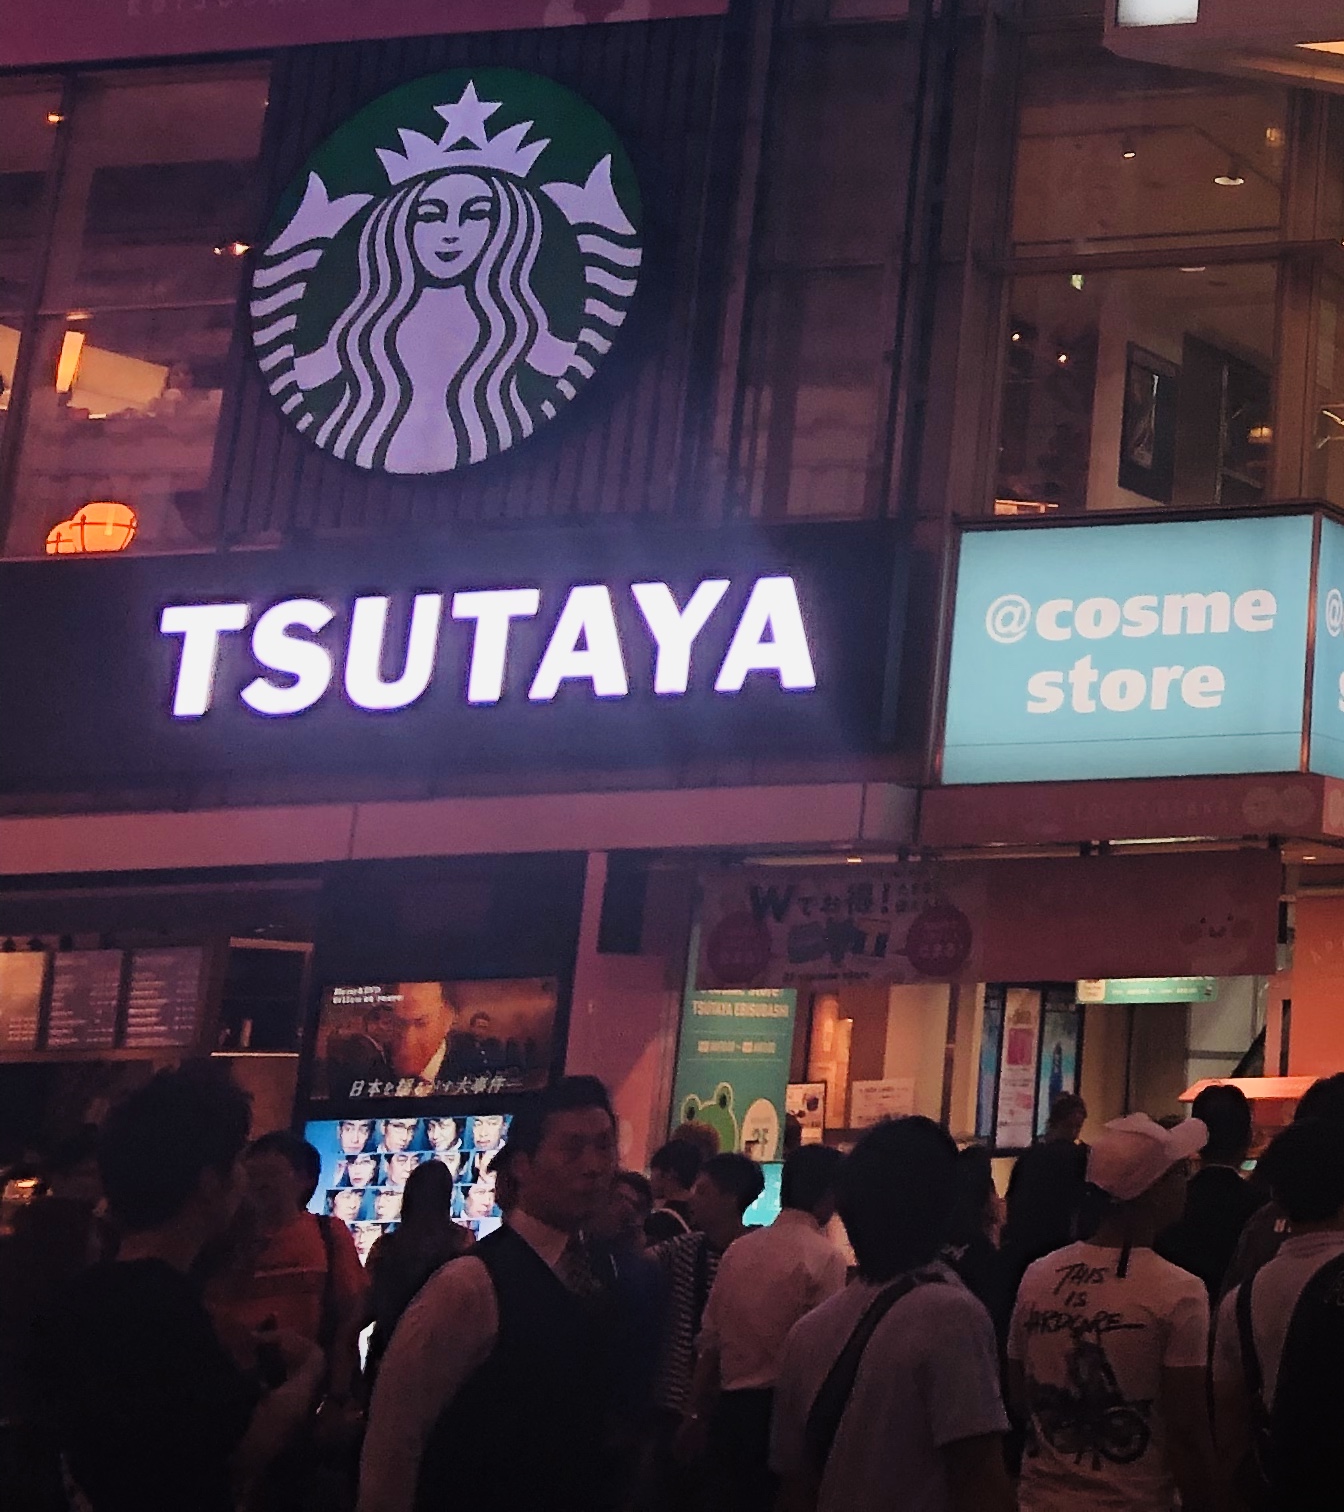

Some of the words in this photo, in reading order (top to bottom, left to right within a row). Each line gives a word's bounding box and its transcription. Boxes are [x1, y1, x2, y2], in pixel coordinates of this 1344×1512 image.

[159, 575, 816, 718] TSUTAYA
[985, 588, 1277, 645] @cosme
[1027, 654, 1225, 714] store
